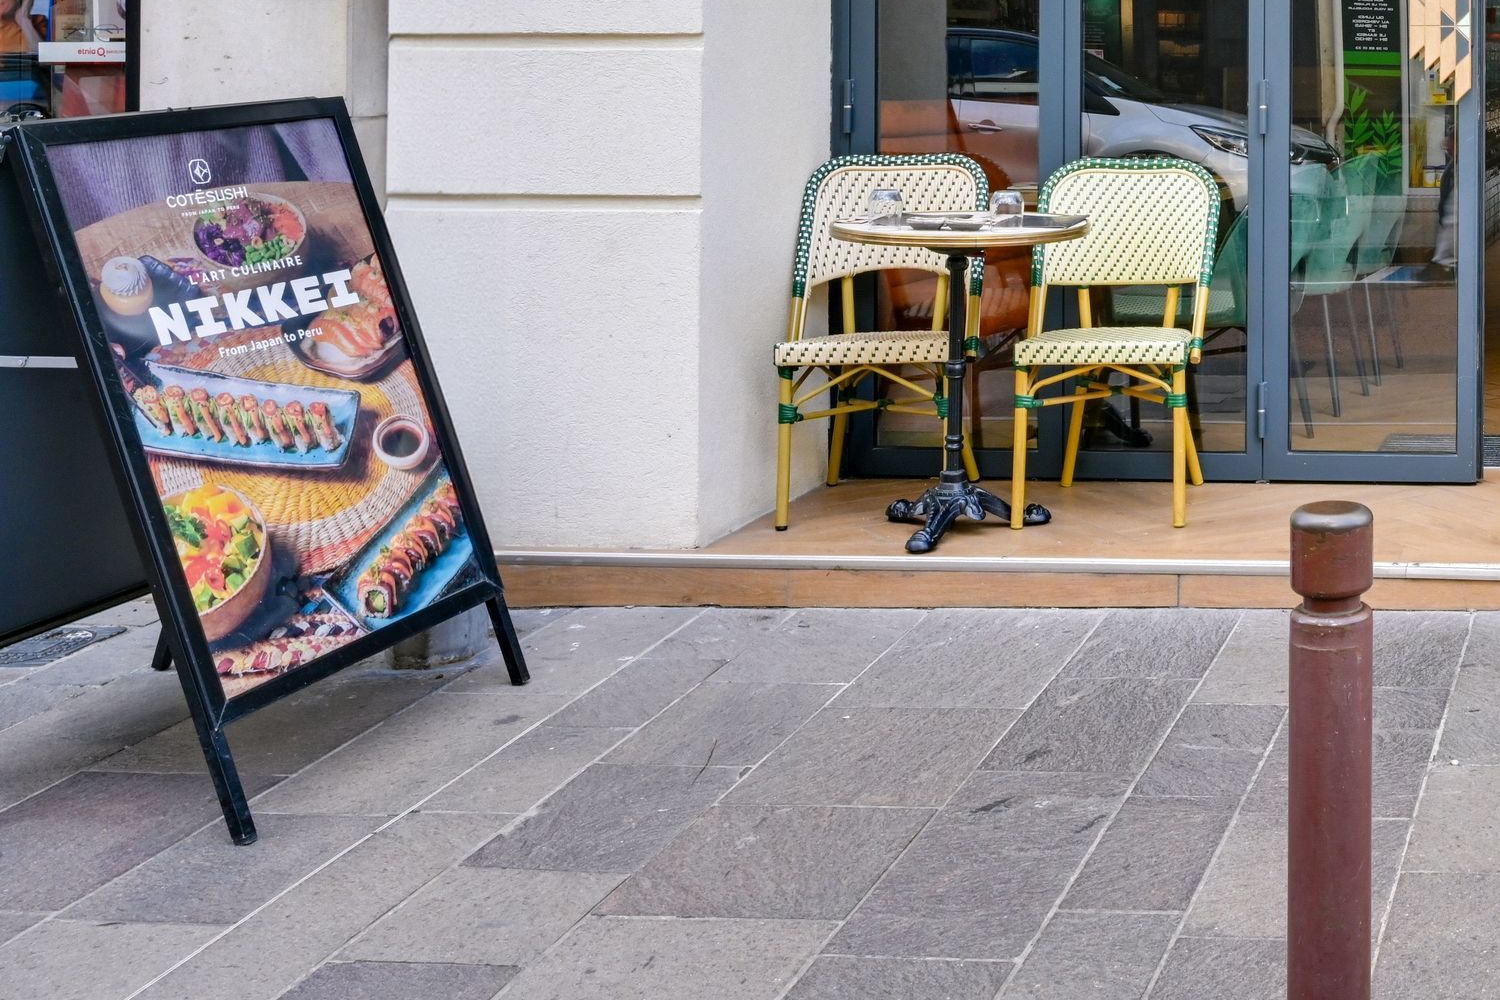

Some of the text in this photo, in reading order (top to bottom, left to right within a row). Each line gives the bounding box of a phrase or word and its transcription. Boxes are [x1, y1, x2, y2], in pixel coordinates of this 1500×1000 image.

[188, 255, 303, 286] L'ART CULINAIRE
[148, 268, 360, 346] NIKKEI
[218, 325, 323, 359] From Japan to Peru
